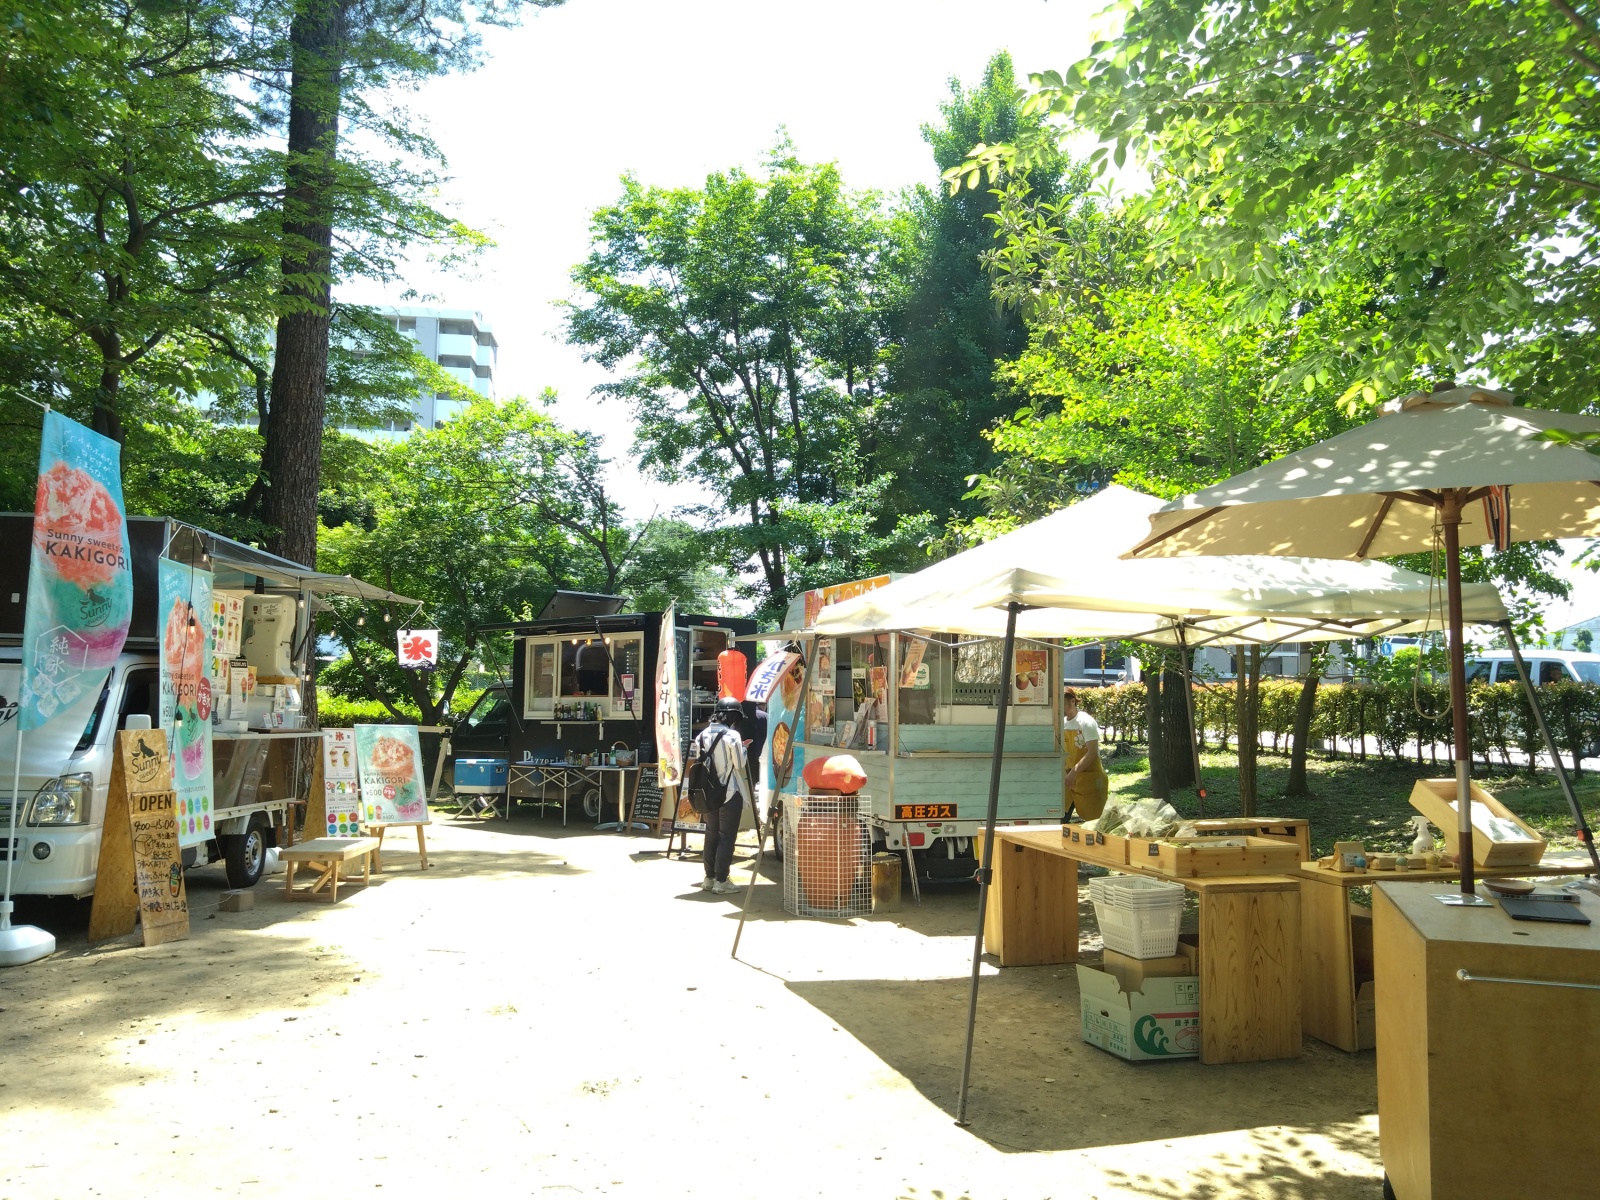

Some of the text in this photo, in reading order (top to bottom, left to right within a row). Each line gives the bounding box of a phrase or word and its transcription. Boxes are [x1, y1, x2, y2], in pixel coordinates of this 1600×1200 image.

[47, 528, 84, 545] Sunny
[45, 541, 130, 571] KAKIGORI
[402, 636, 433, 661] 氷
[162, 681, 197, 697] KAKIGORI
[131, 751, 162, 775] Sunny
[364, 776, 406, 785] KAKIGORI
[140, 794, 172, 811] OPEN
[901, 805, 951, 818] 高圧ガス
